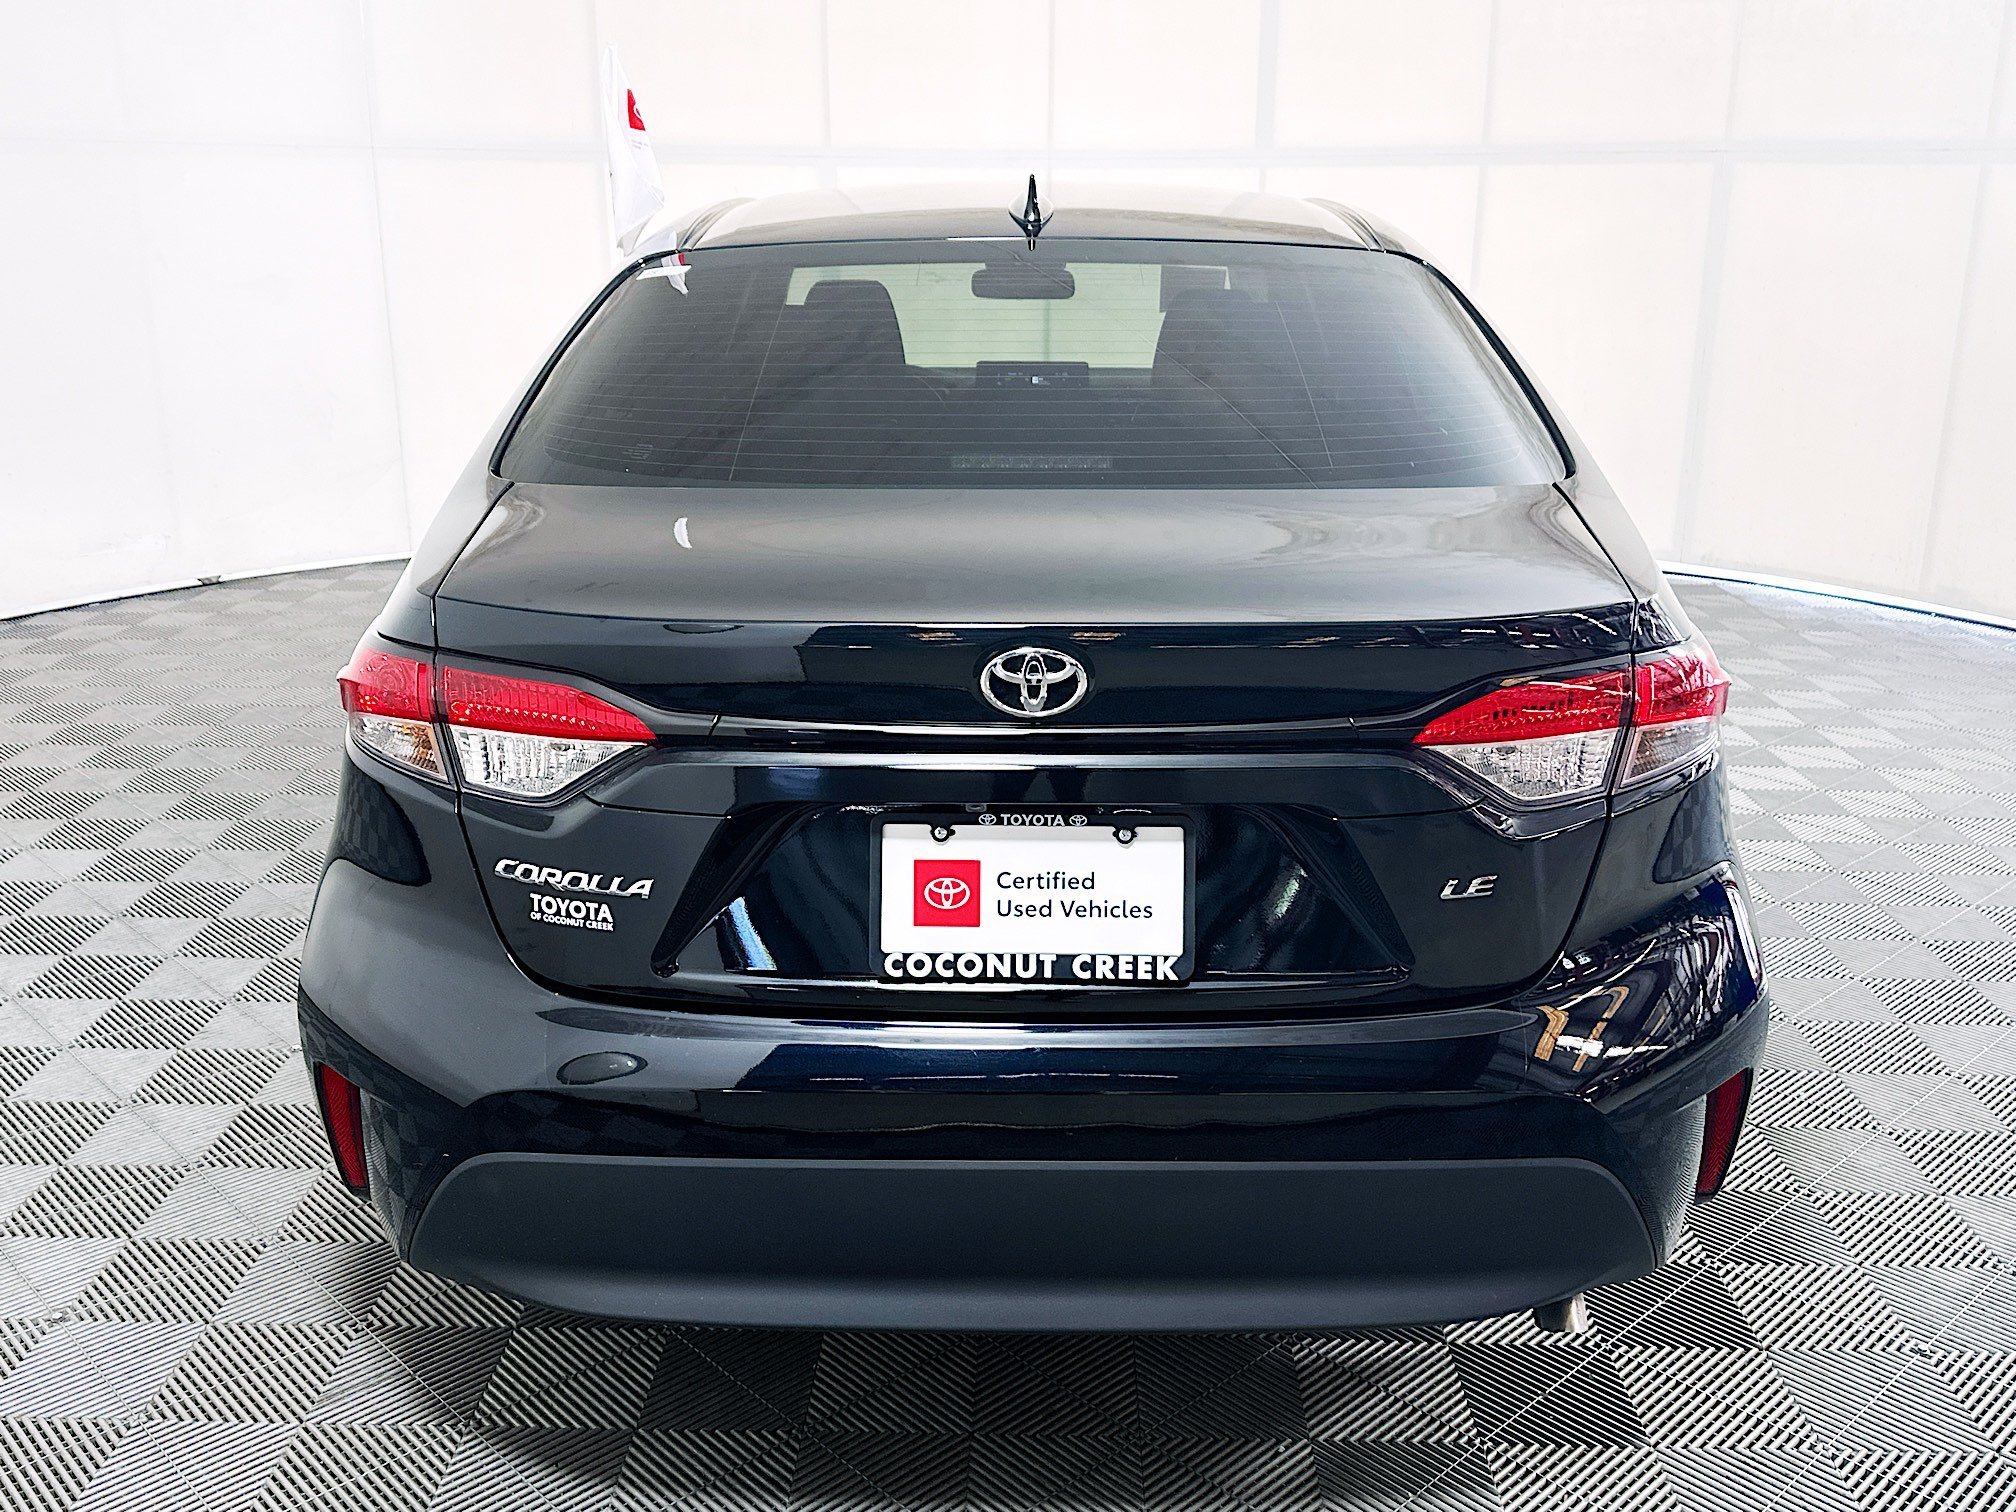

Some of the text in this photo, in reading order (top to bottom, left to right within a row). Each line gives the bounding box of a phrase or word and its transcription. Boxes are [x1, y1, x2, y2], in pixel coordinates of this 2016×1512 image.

[1000, 813, 1066, 828] TOYOTA
[494, 858, 655, 900] COROLLA
[996, 871, 1096, 890] Certified
[1440, 875, 1498, 900] LE
[529, 892, 614, 923] TOYOTA
[996, 899, 1153, 919] Used Vehicles
[530, 911, 614, 932] OF COCONUT CREEK
[883, 952, 1180, 981] COCONUT CREEK
